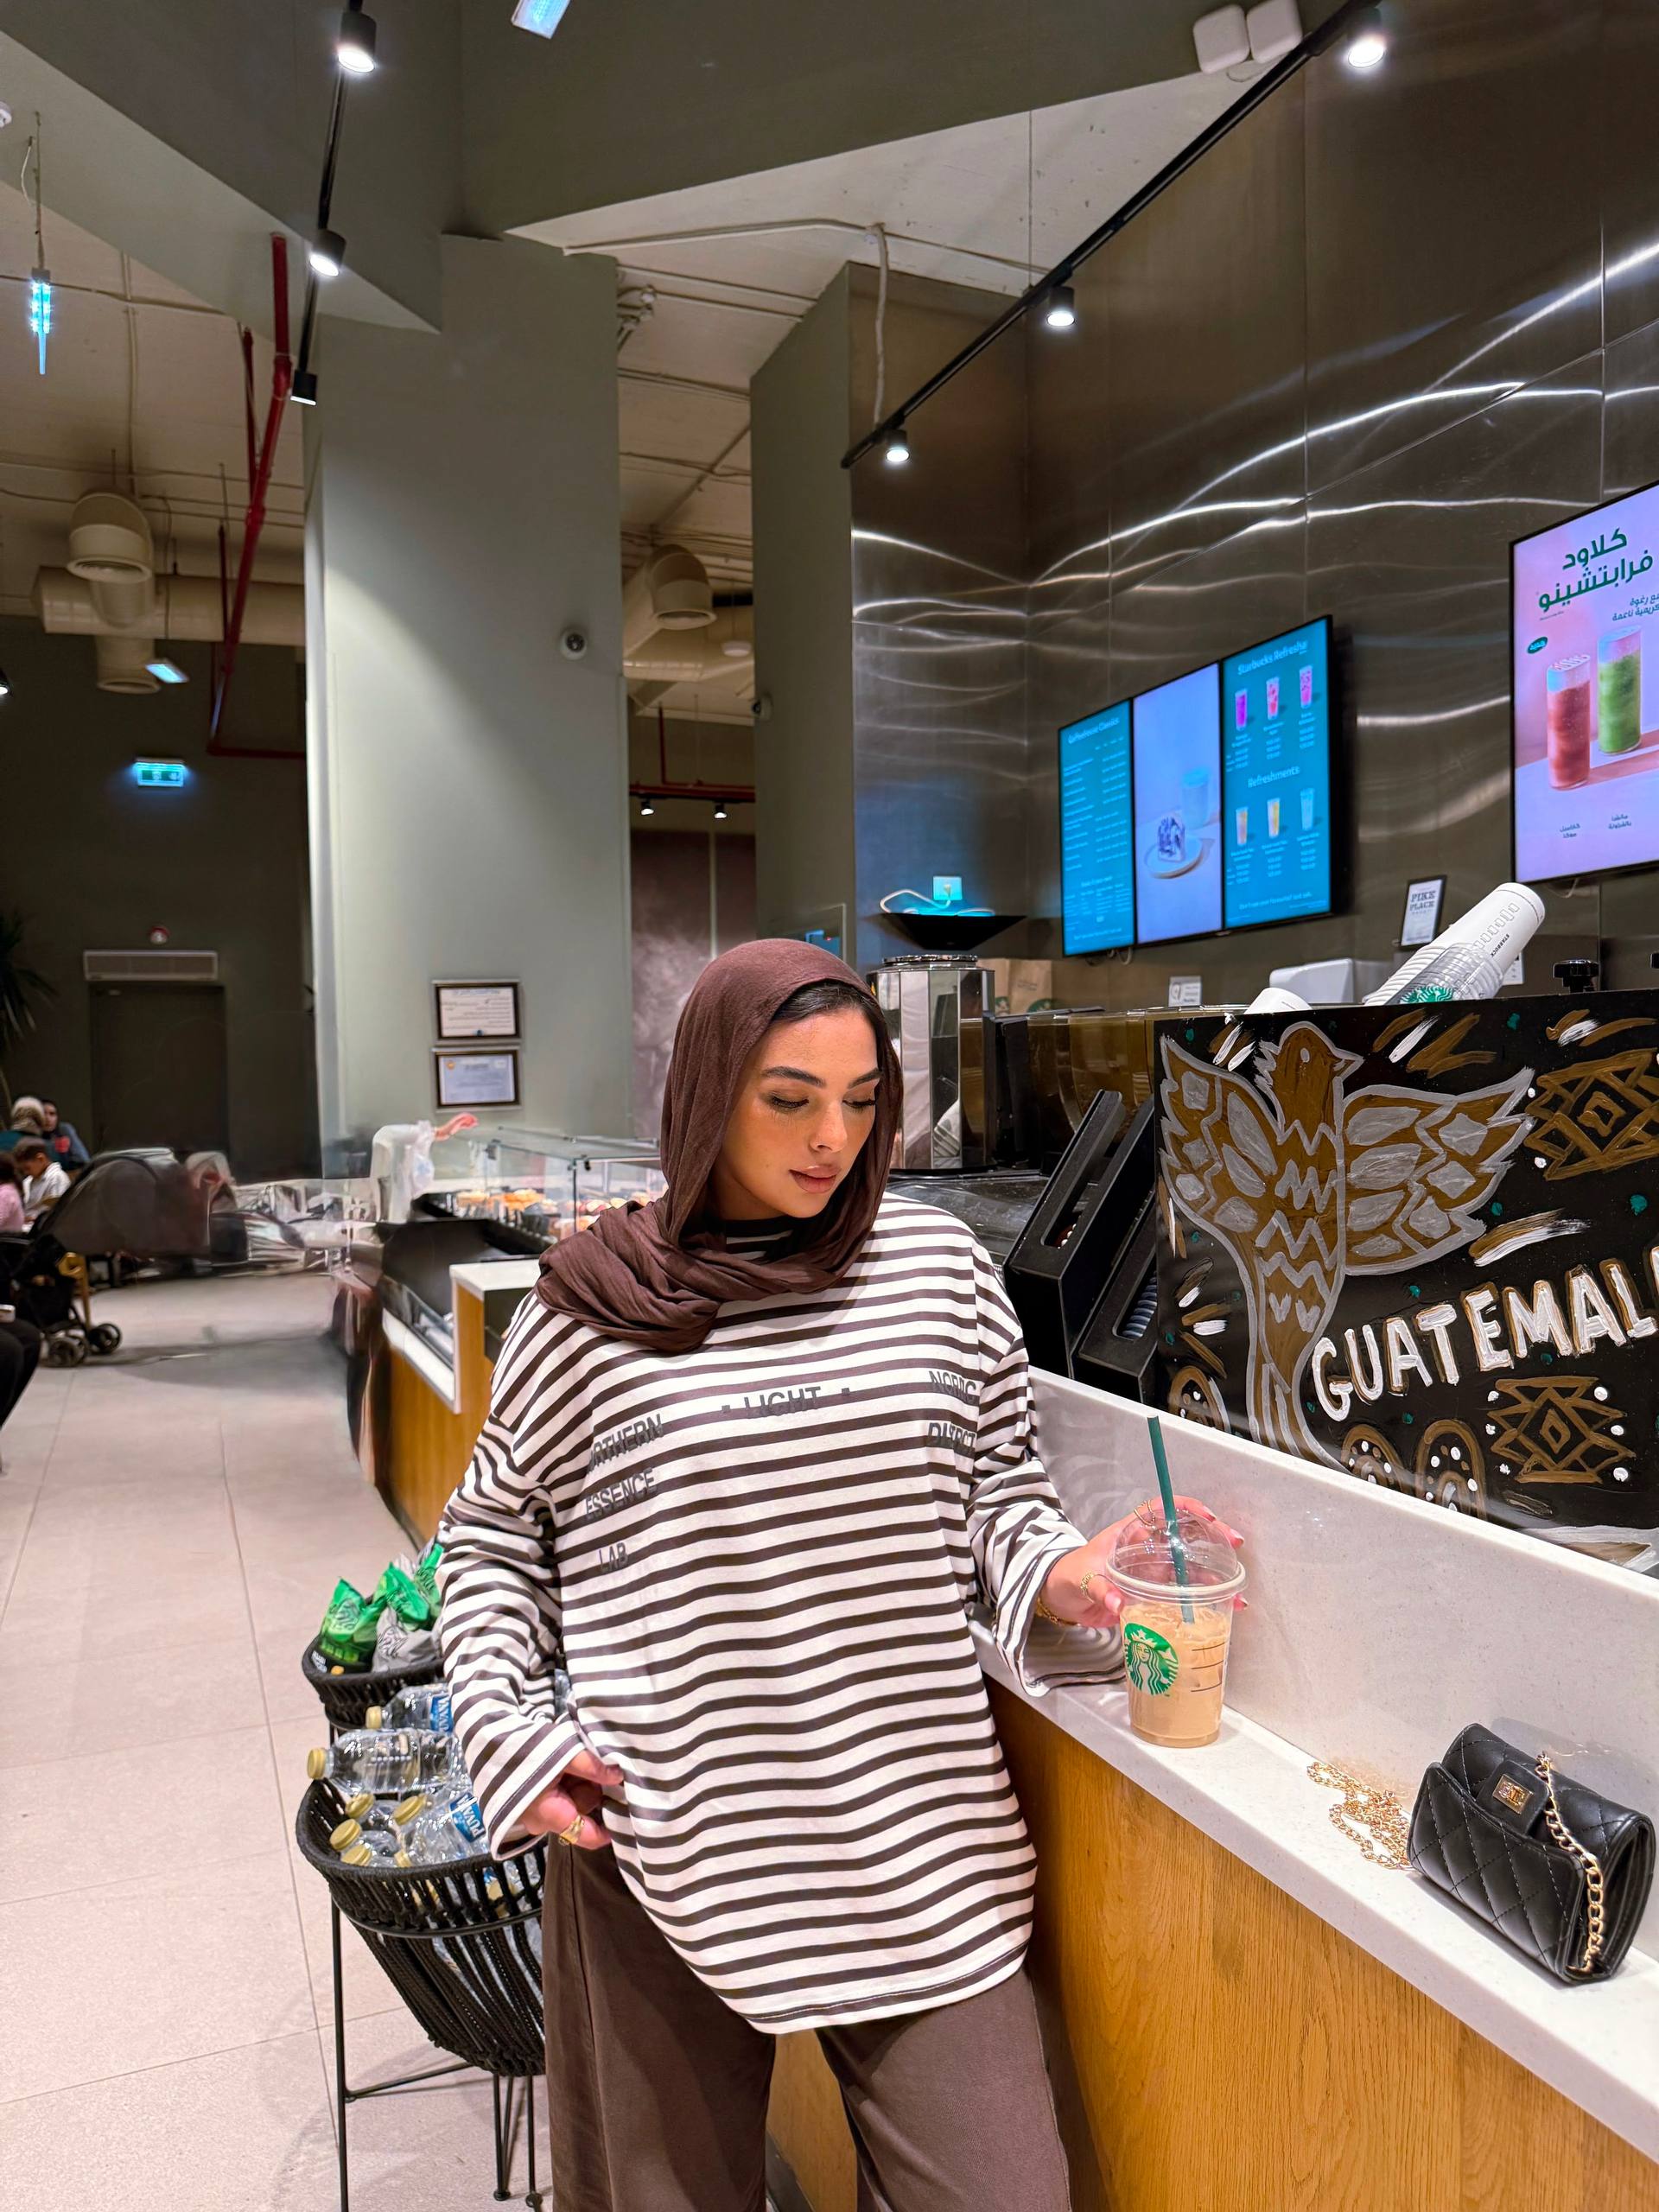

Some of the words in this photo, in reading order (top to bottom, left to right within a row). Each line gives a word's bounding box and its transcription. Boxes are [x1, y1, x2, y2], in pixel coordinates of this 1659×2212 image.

[1562, 527, 1628, 570] كلاود
[1538, 550, 1654, 613] فرابتشينو
[1411, 890, 1435, 902] PIKE
[1491, 933, 1510, 957] STARBUCK
[1312, 1246, 1659, 1422] GUATEMAL
[744, 1386, 821, 1419] LIGHT
[585, 1468, 658, 1520] ESSENCE
[598, 1542, 629, 1573] LAB
